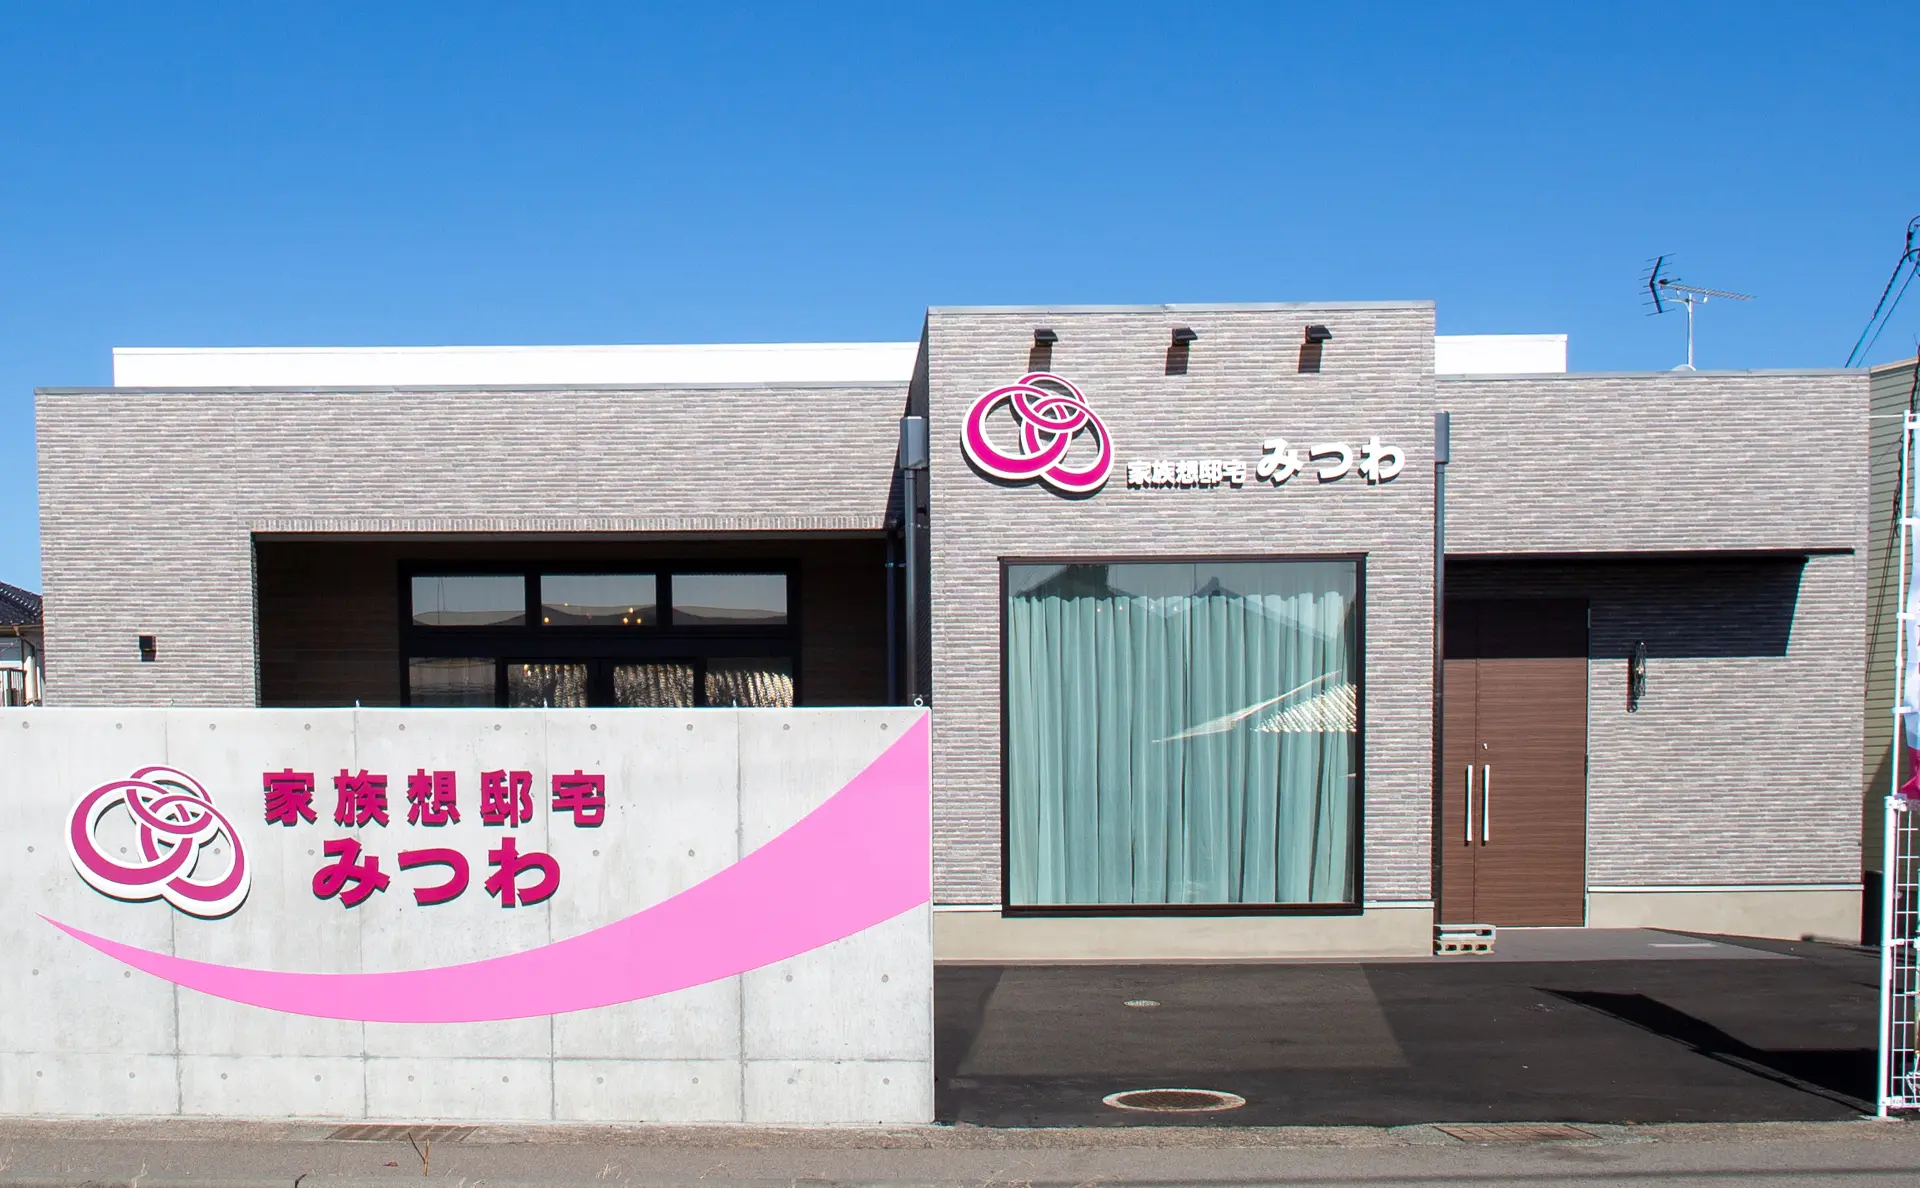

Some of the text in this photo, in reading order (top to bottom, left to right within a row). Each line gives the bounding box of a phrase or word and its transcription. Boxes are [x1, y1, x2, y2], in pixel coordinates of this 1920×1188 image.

[1127, 436, 1406, 486] 家族想邸宅 みつわ
[262, 768, 606, 826] 家族想邸宅
[312, 836, 561, 907] みつわ
